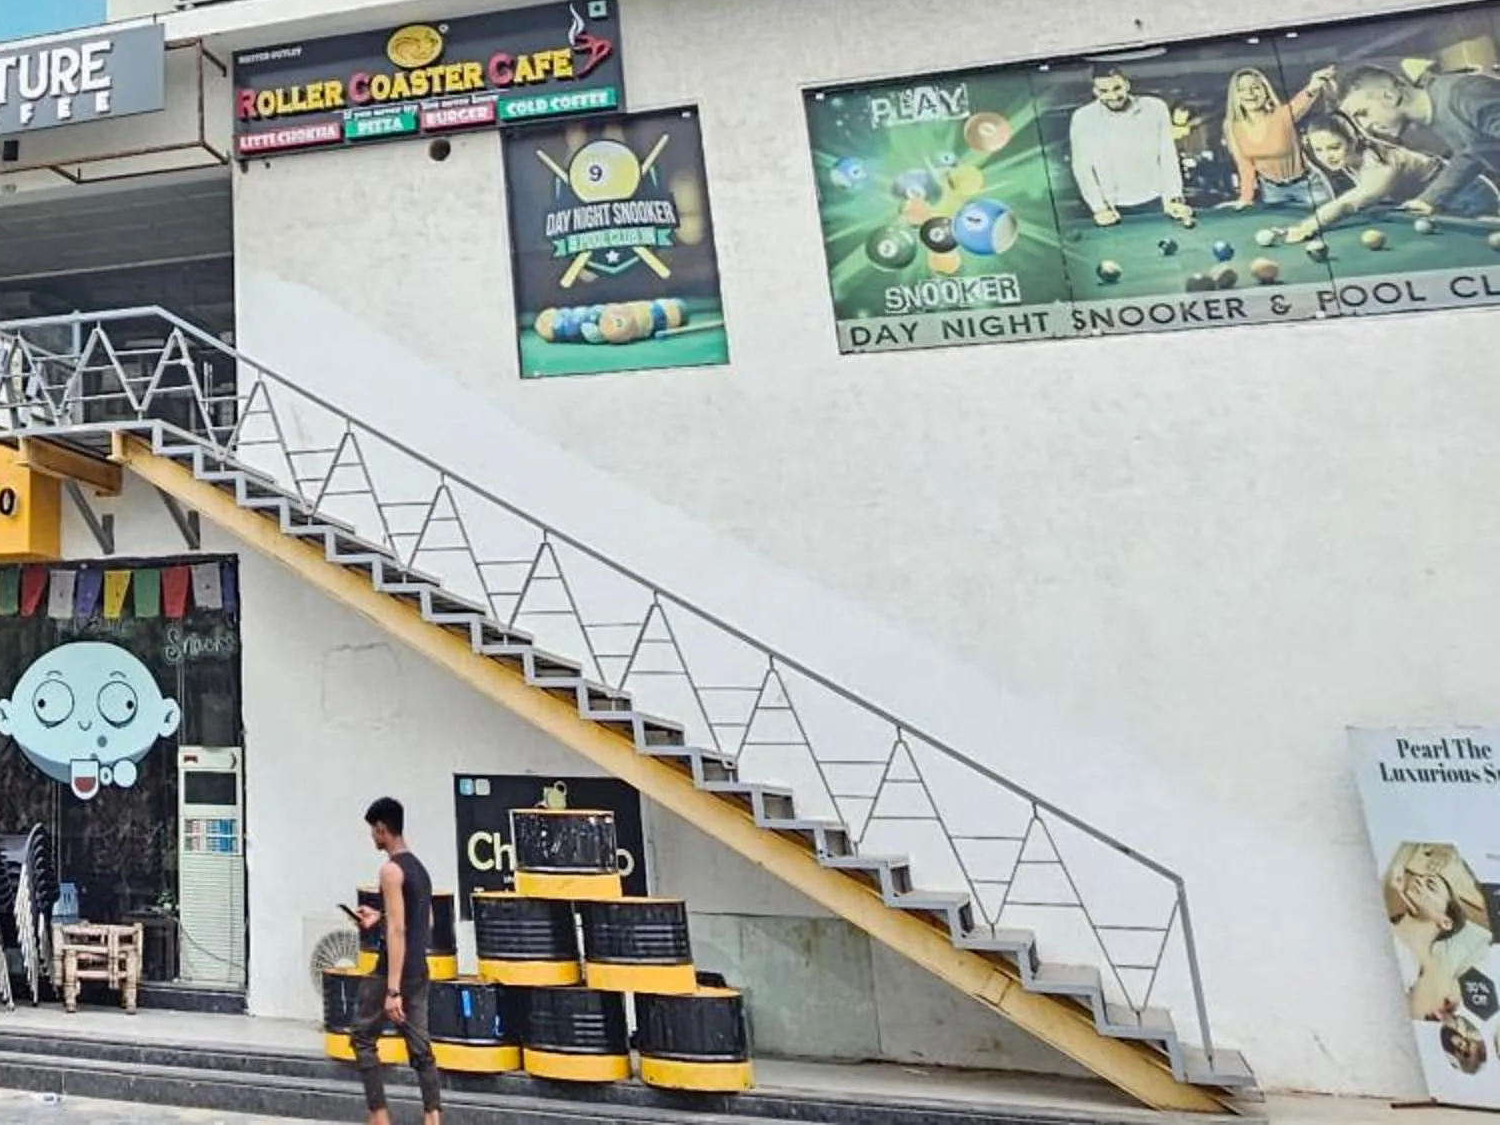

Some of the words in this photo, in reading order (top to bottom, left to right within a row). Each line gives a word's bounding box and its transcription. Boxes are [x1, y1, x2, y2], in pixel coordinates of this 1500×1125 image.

[236, 79, 345, 119] ROLLER
[348, 62, 485, 103] COASTER
[488, 47, 574, 88] CAFE
[424, 106, 489, 125] BURGER
[506, 99, 549, 116] COLD
[552, 91, 609, 109] COFFEE
[870, 82, 971, 129] PLAY
[588, 164, 603, 182] 9
[545, 209, 571, 237] DAY
[573, 203, 611, 230] NIGHT
[612, 200, 677, 225] SNOOKER
[885, 274, 1021, 314] SNOOKER
[850, 321, 918, 347] DAY
[941, 311, 1049, 340] NIGHT
[1072, 297, 1248, 330] SNOOKER
[1269, 293, 1293, 316] &
[1316, 280, 1427, 312] POOL
[1396, 737, 1451, 759] Pearl
[1452, 737, 1493, 760] The
[1379, 761, 1482, 783] Luxurious
[1483, 763, 1500, 784] S
